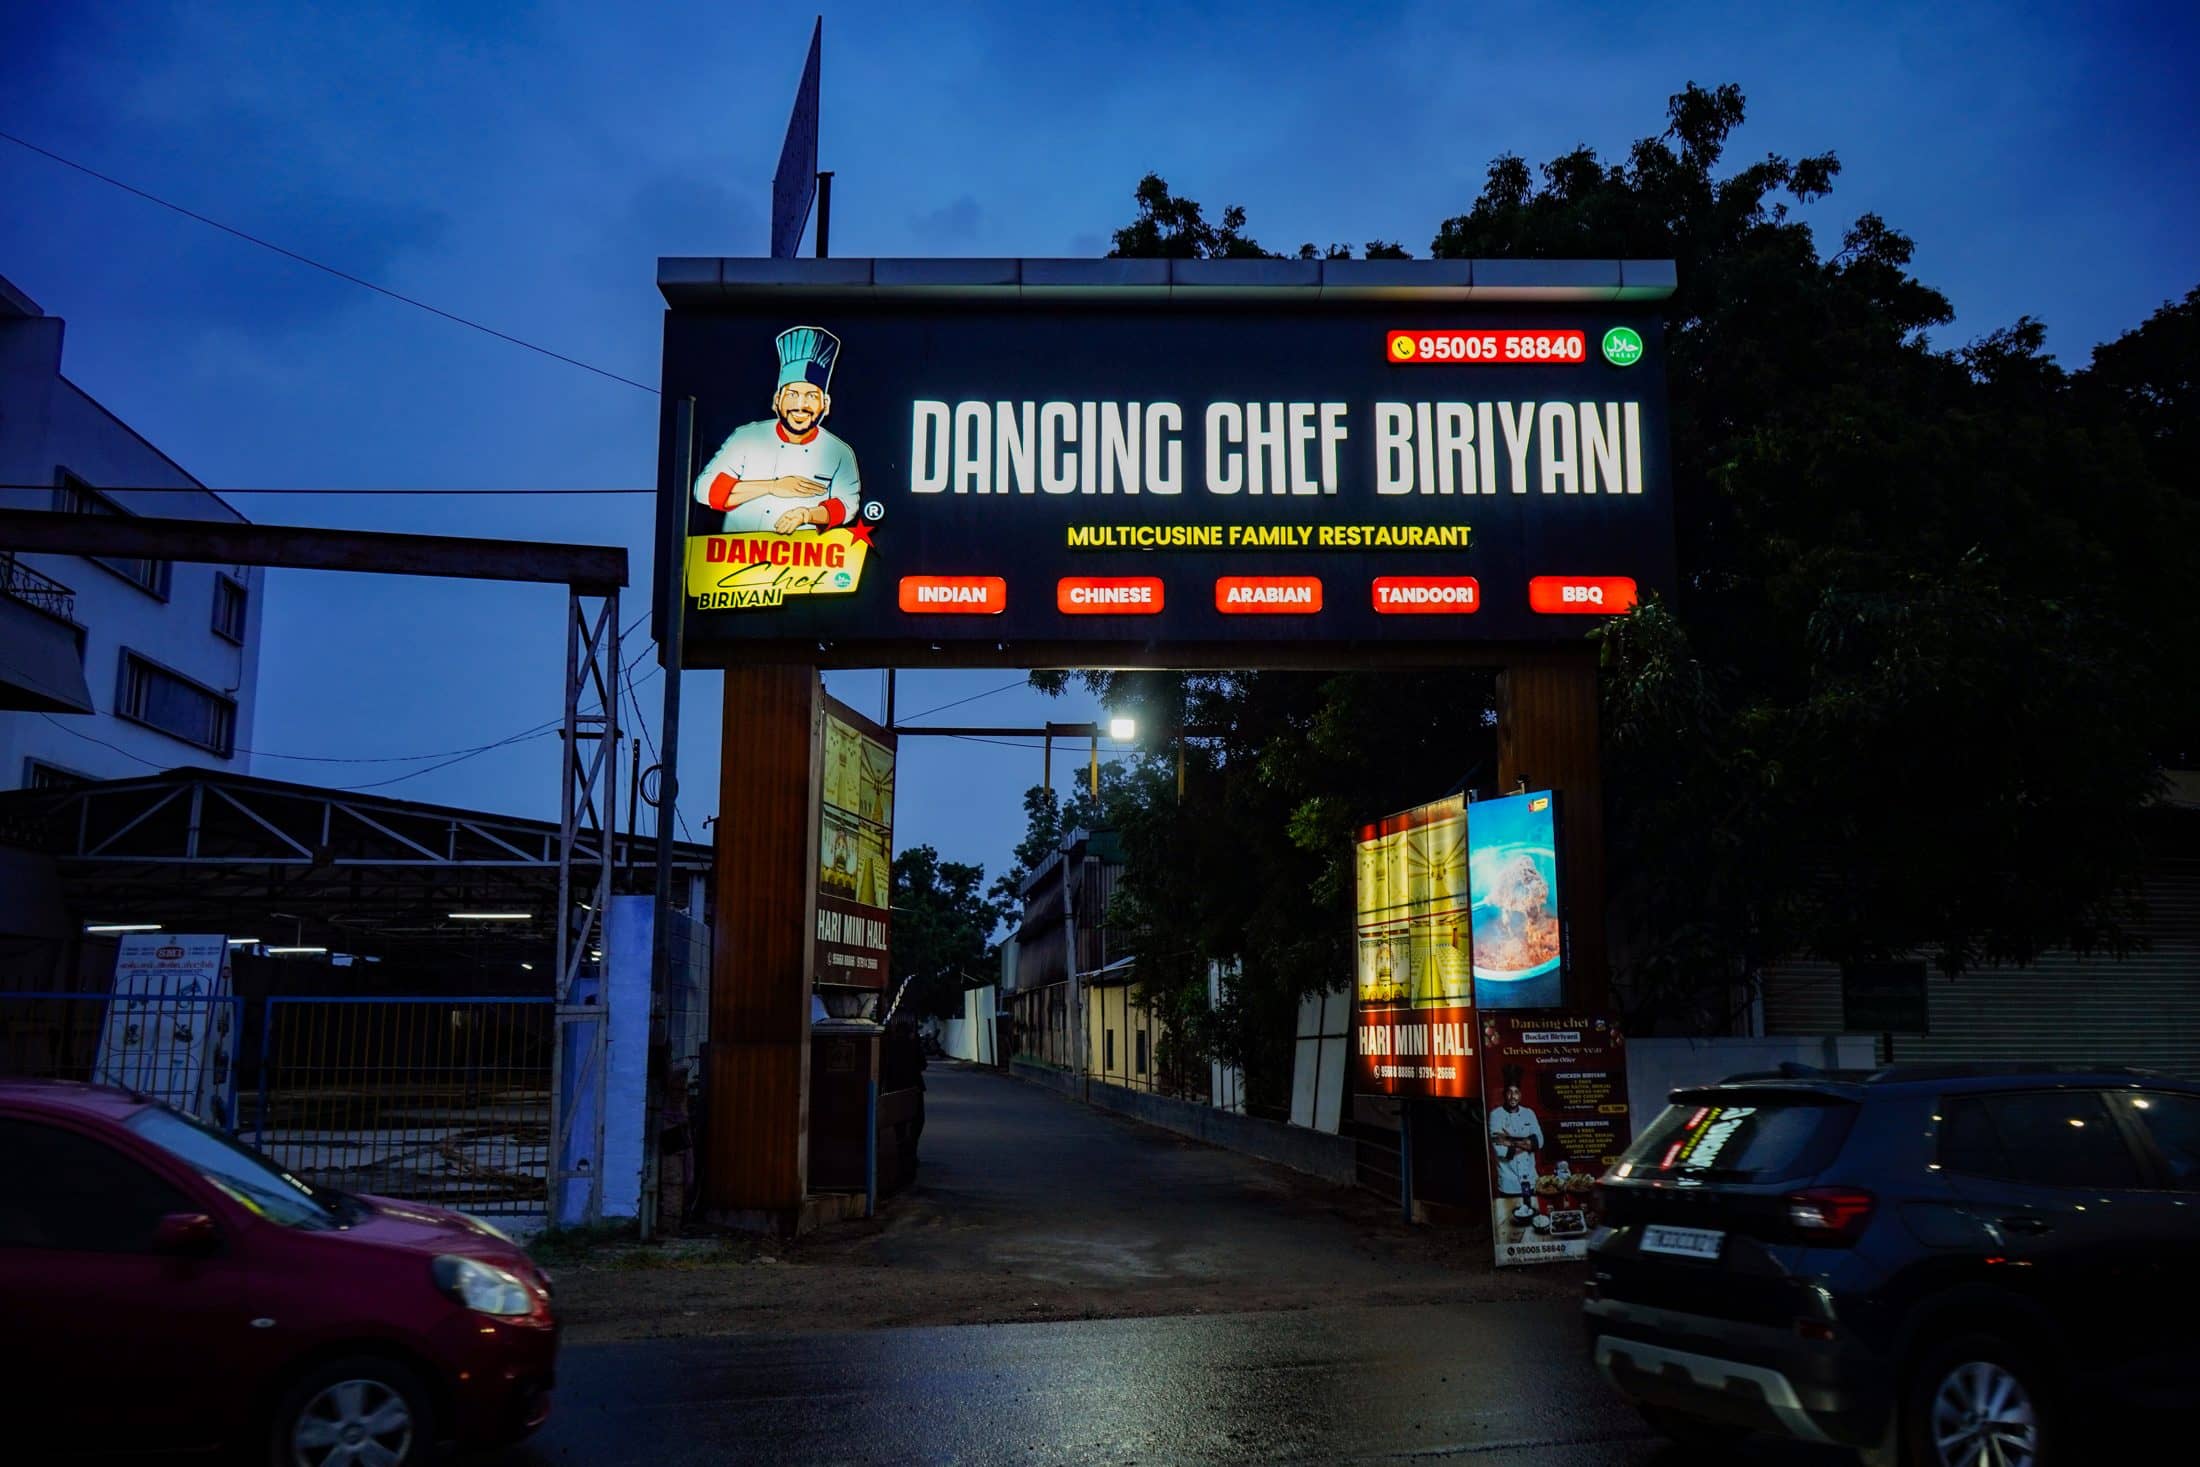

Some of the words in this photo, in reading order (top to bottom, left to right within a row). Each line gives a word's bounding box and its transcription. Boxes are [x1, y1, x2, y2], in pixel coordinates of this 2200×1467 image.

[1419, 336, 1498, 359] 95005
[1505, 336, 1582, 359] 58840
[911, 400, 1182, 495] DANCING
[1205, 401, 1348, 495] CHEF
[1375, 401, 1642, 495] BIRIYANI
[1067, 526, 1223, 546] MULTICUSINE
[1229, 526, 1313, 546] FAMILY
[1318, 526, 1472, 546] RESTAURANT
[705, 537, 846, 568] DANCING
[717, 561, 828, 594] Chef
[698, 589, 783, 609] BIRIYANI
[917, 586, 987, 603] INDIAN
[1070, 586, 1152, 604] CHINESE
[1226, 586, 1312, 603] ARABIAN
[1378, 587, 1474, 604] TANDOORI
[1561, 586, 1603, 605] BBQ
[817, 908, 842, 943] HARI
[843, 914, 865, 947] MINI
[866, 919, 888, 951] HALL
[1359, 1024, 1391, 1056] HARI
[1394, 1024, 1429, 1056] MINI
[1432, 1022, 1474, 1056] HALL
